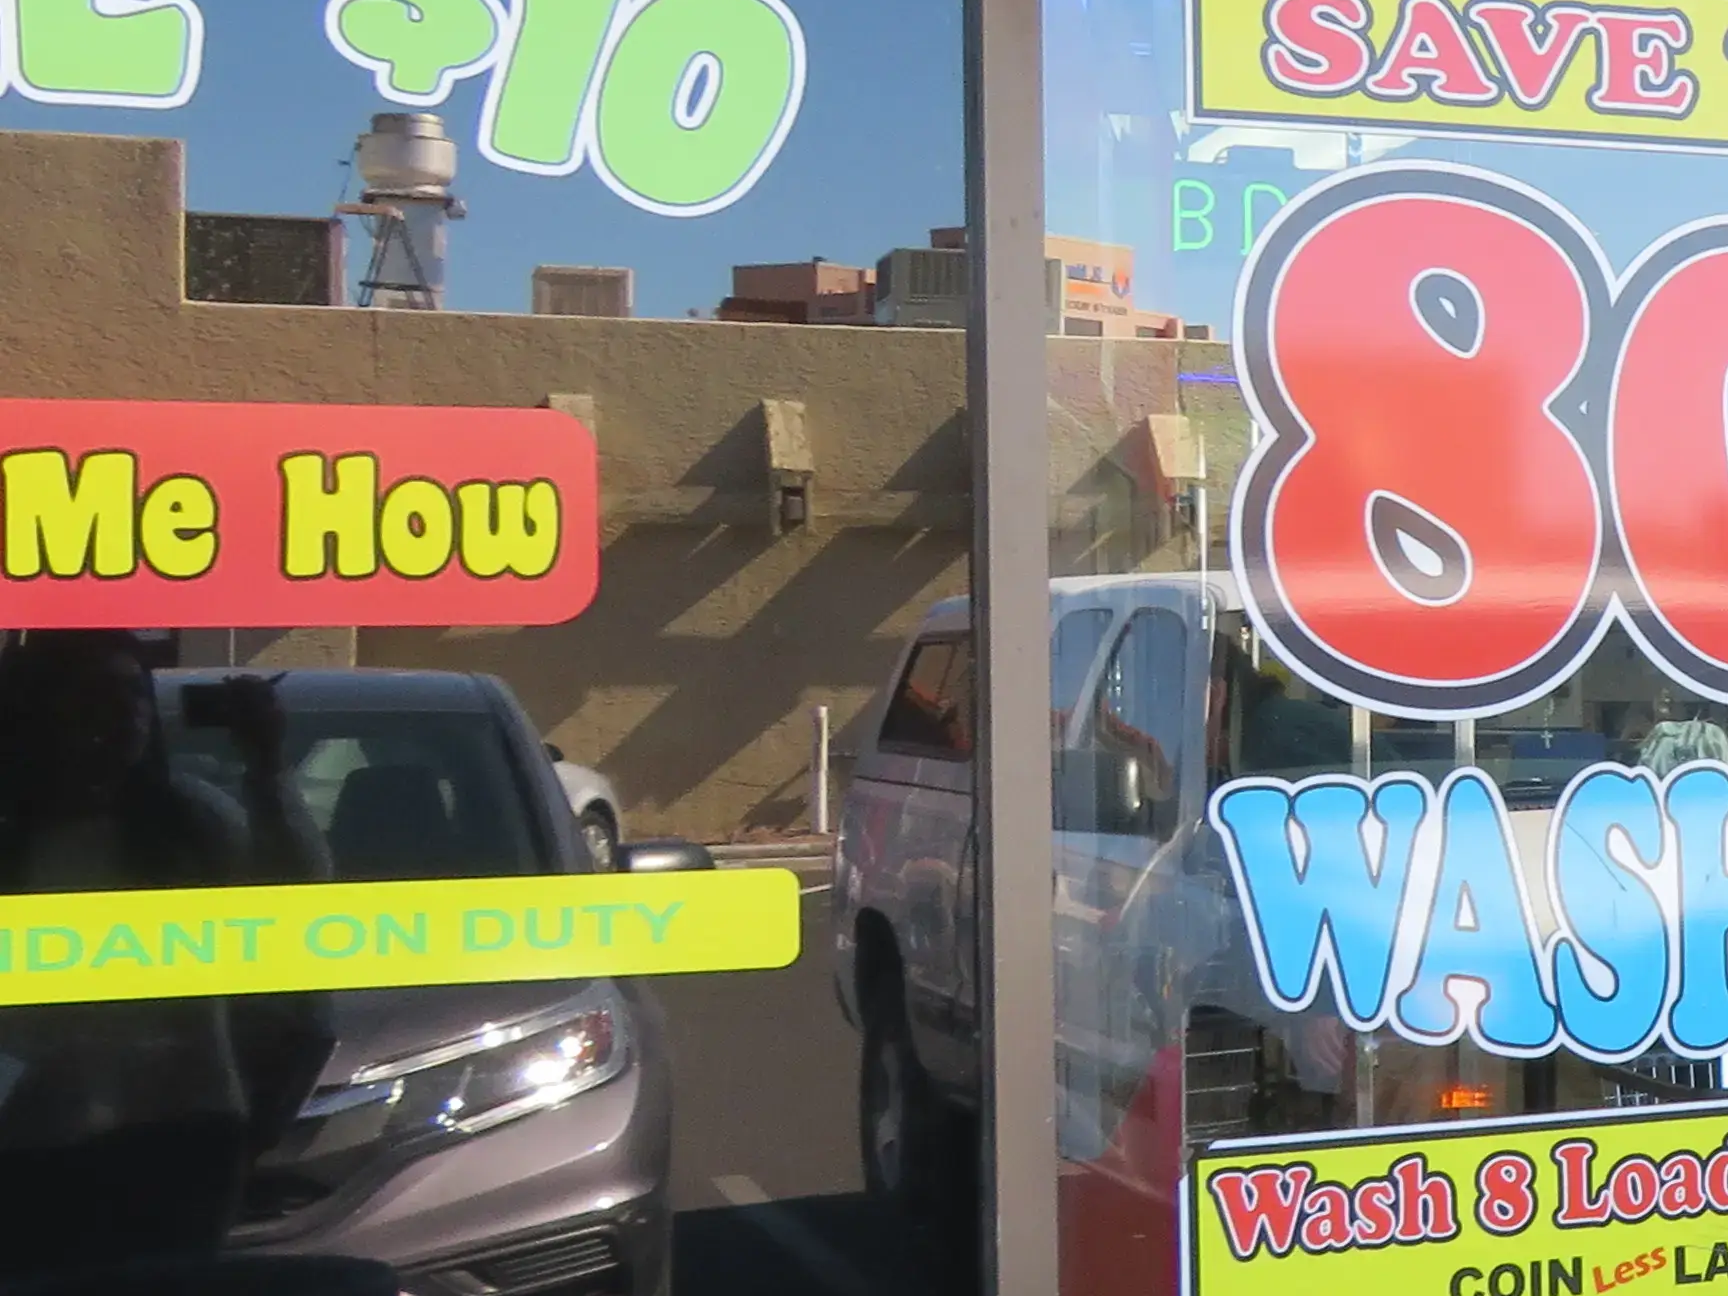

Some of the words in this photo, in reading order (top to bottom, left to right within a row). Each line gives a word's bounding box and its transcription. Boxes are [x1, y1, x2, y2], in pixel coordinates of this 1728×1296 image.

[1, 448, 218, 581] Me
[280, 450, 562, 582] How
[305, 911, 429, 960] ON
[462, 902, 687, 954] DUTY
[1208, 1151, 1461, 1263] Wash
[1475, 1150, 1537, 1236] 8
[1592, 1246, 1668, 1294] Less
